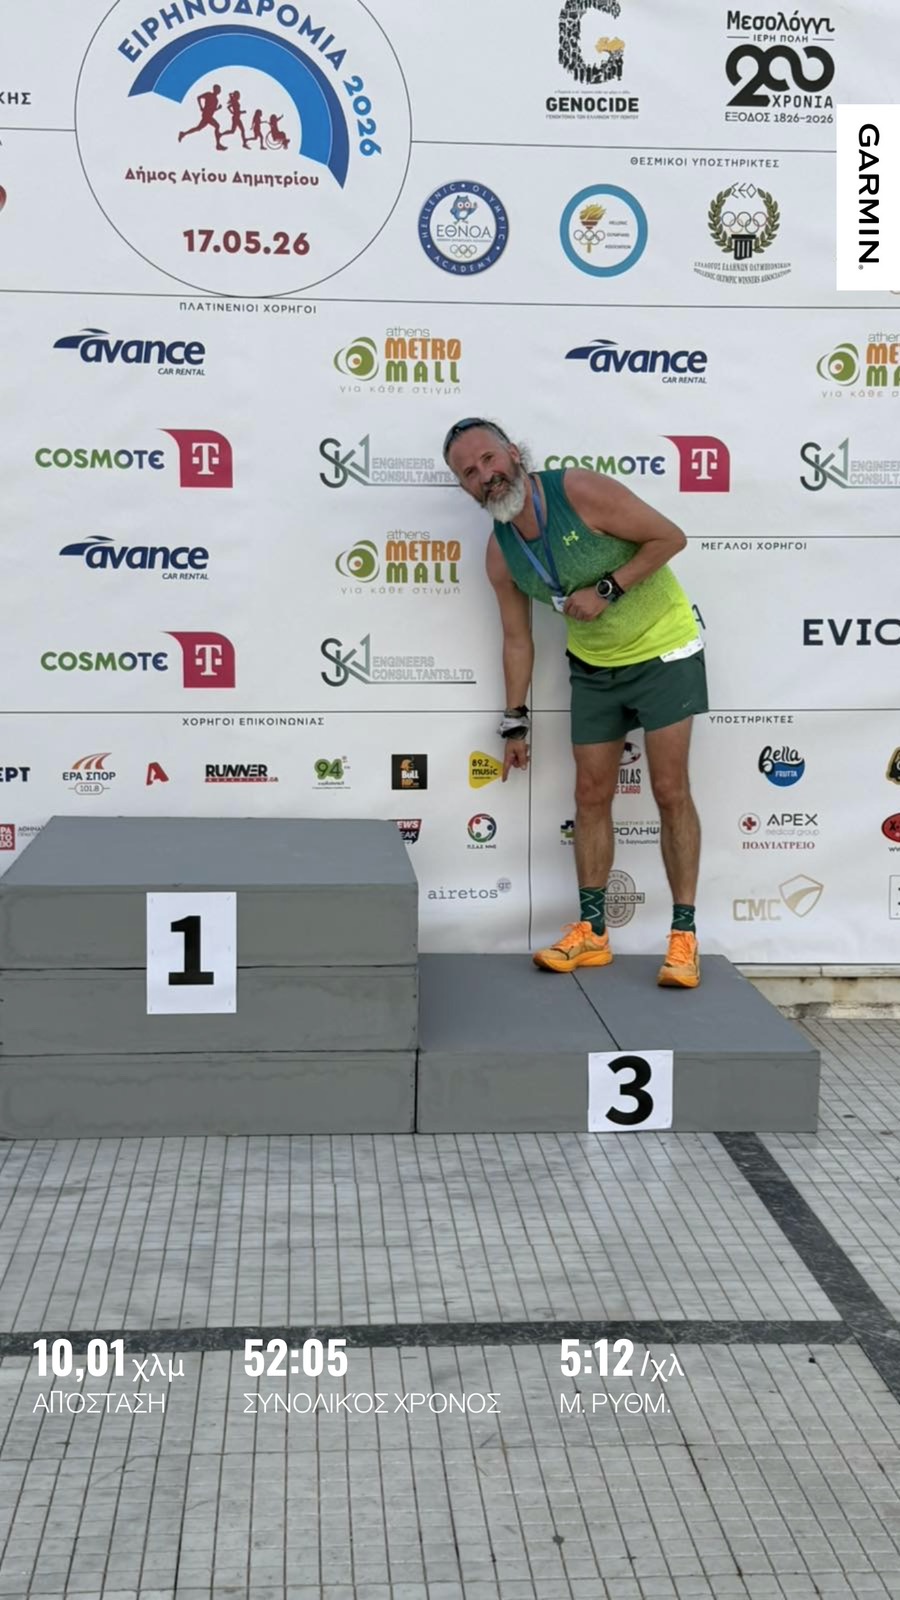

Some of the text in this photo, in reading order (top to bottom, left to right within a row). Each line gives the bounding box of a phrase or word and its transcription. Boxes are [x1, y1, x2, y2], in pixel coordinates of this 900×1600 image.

[727, 10, 835, 34] Μεσολόγγι
[753, 34, 808, 43] ΙΕΡΗ ΠΟΛΗ
[725, 44, 835, 107] 200
[546, 97, 639, 112] GENOCIDE
[772, 95, 833, 109] ΧΡΟΝΙΑ
[342, 75, 382, 156] 2026
[725, 111, 833, 123] ΕΞΟΔΟΣ 1826-2026
[630, 156, 780, 168] ΘΕΣΜΙΚΟΙ ΥΠΟΣΤΗΡΙΚΤΕΣ
[125, 166, 319, 188] Δήμος Αγίου Δημητρίου
[421, 184, 506, 240] HELLENIC OLYMPIC
[183, 229, 310, 256] 17.05.26
[434, 256, 491, 273] ACADEMY
[179, 302, 317, 314] ΠΛΑΤΙΝΕΝΙΟΙ ΧΟΡΗΓΟΙ
[386, 326, 430, 337] athens
[80, 338, 205, 365] avance
[590, 349, 707, 373] avance
[158, 368, 205, 376] CAR RENTAL
[386, 361, 460, 383] MALL
[339, 384, 462, 395] για κάθε στιγμή
[822, 390, 842, 398] για
[850, 389, 883, 398] κάθε
[35, 448, 165, 470] COSMOTE
[372, 458, 435, 469] ENGINEERS
[545, 455, 665, 475] COSMOTE
[386, 529, 430, 540] athens
[701, 542, 807, 550] ΜΕΓΑΛΟΙ ΧΟΡΗΓΟΙ
[86, 546, 209, 569] avance
[386, 562, 460, 583] MALL
[340, 586, 461, 595] για κάθε στιγμή
[41, 651, 168, 672] COSMOTE
[372, 656, 435, 667] ENGINEERS
[182, 717, 325, 726] ΧΟΡΗΓΟΙ ΕΠΙΚΟΙΝΩΝΙΑΣ
[709, 715, 794, 724] ΥΠΟΣΤΗΡΙΚΤΕΣ
[758, 745, 801, 773] Bella
[0, 767, 31, 782] ΡΤ
[62, 772, 116, 781] ΕΡΑ ΣΠΟΡ
[206, 764, 268, 777] RUNNER
[472, 766, 498, 776] music
[767, 814, 818, 826] APEX
[797, 829, 819, 837] group
[742, 841, 815, 850] ΠΟΛΥΙΑΤΡΕΙΟ
[428, 886, 498, 900] airetos
[733, 899, 781, 921] CMC
[168, 915, 214, 985] 1
[605, 1055, 653, 1125] 3
